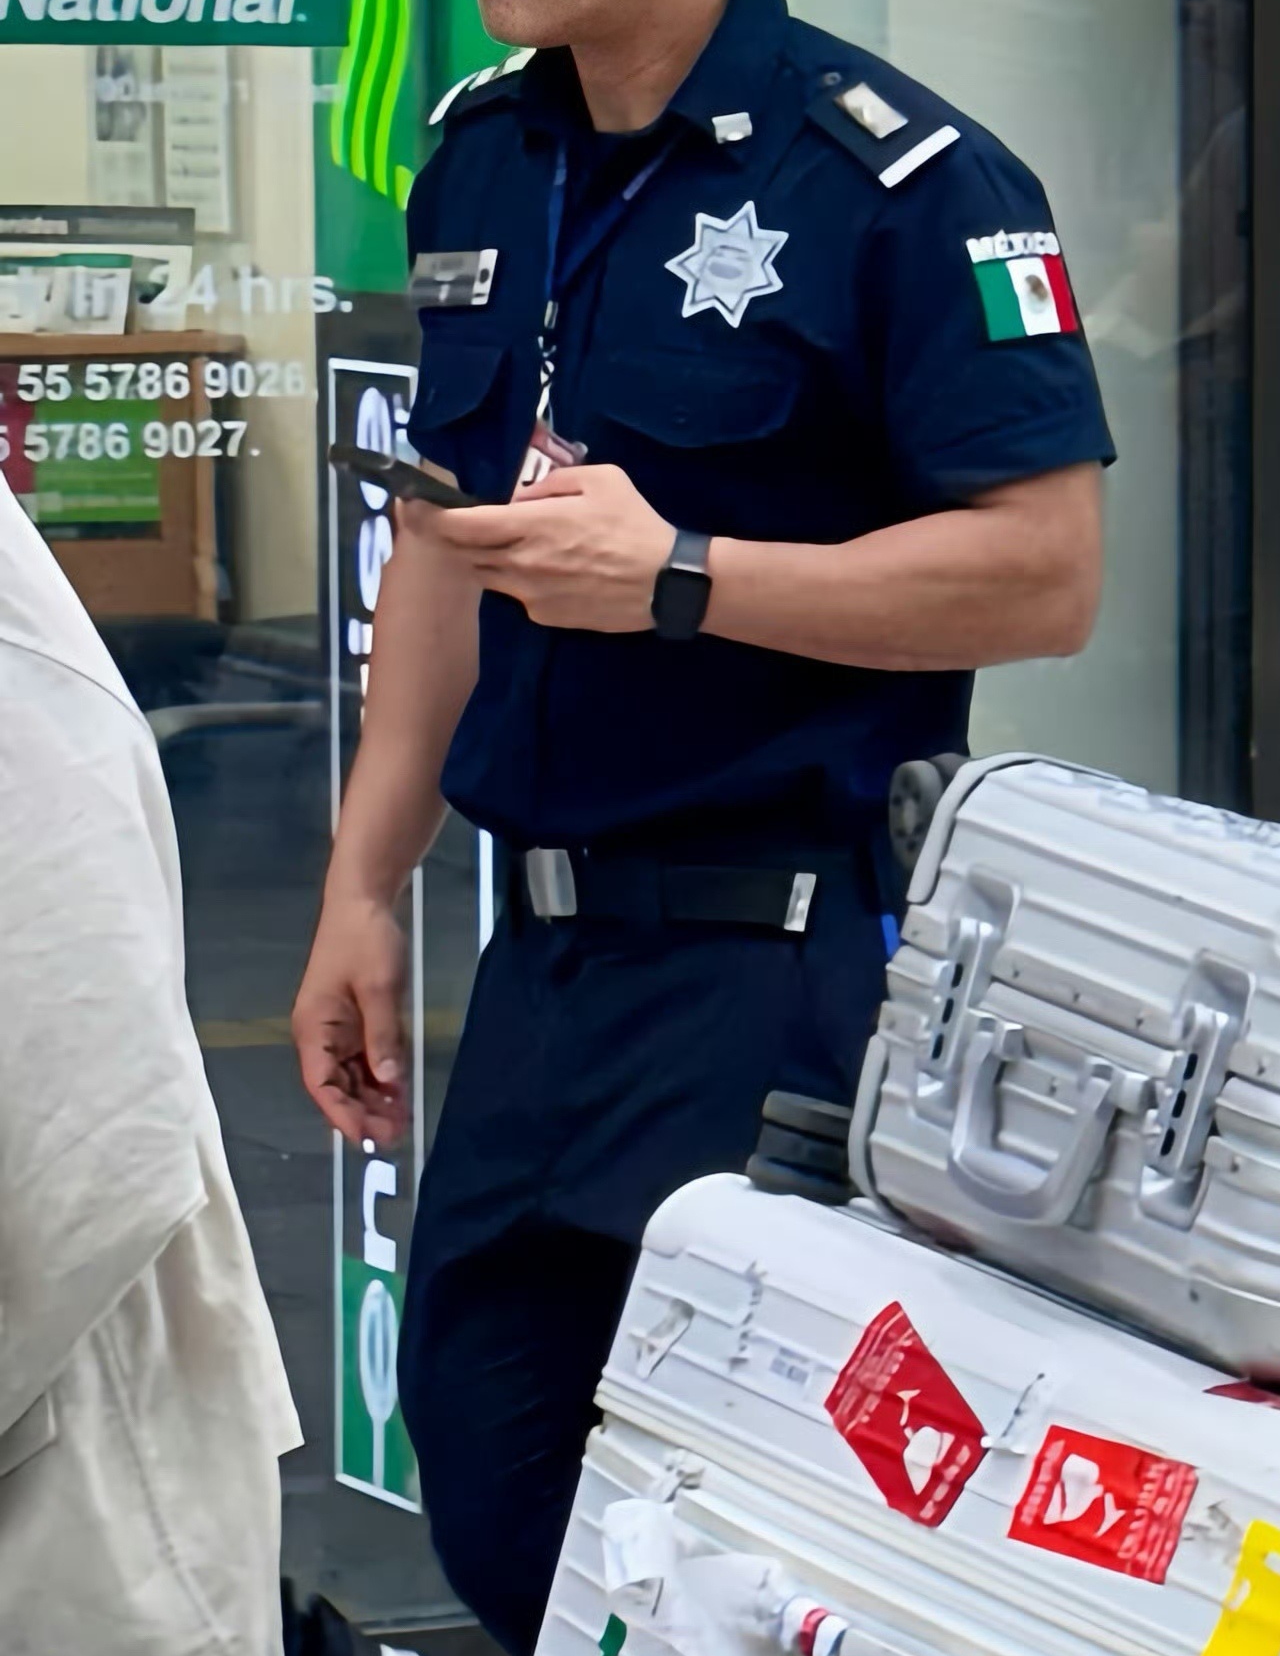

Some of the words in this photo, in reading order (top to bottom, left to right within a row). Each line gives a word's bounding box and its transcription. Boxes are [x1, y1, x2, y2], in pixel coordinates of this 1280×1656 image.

[148, 263, 217, 315] 24
[239, 263, 353, 313] hrs.
[17, 364, 72, 401] 55
[84, 362, 191, 401] 5786
[24, 421, 131, 462] 5786
[143, 420, 260, 459] 9027.
